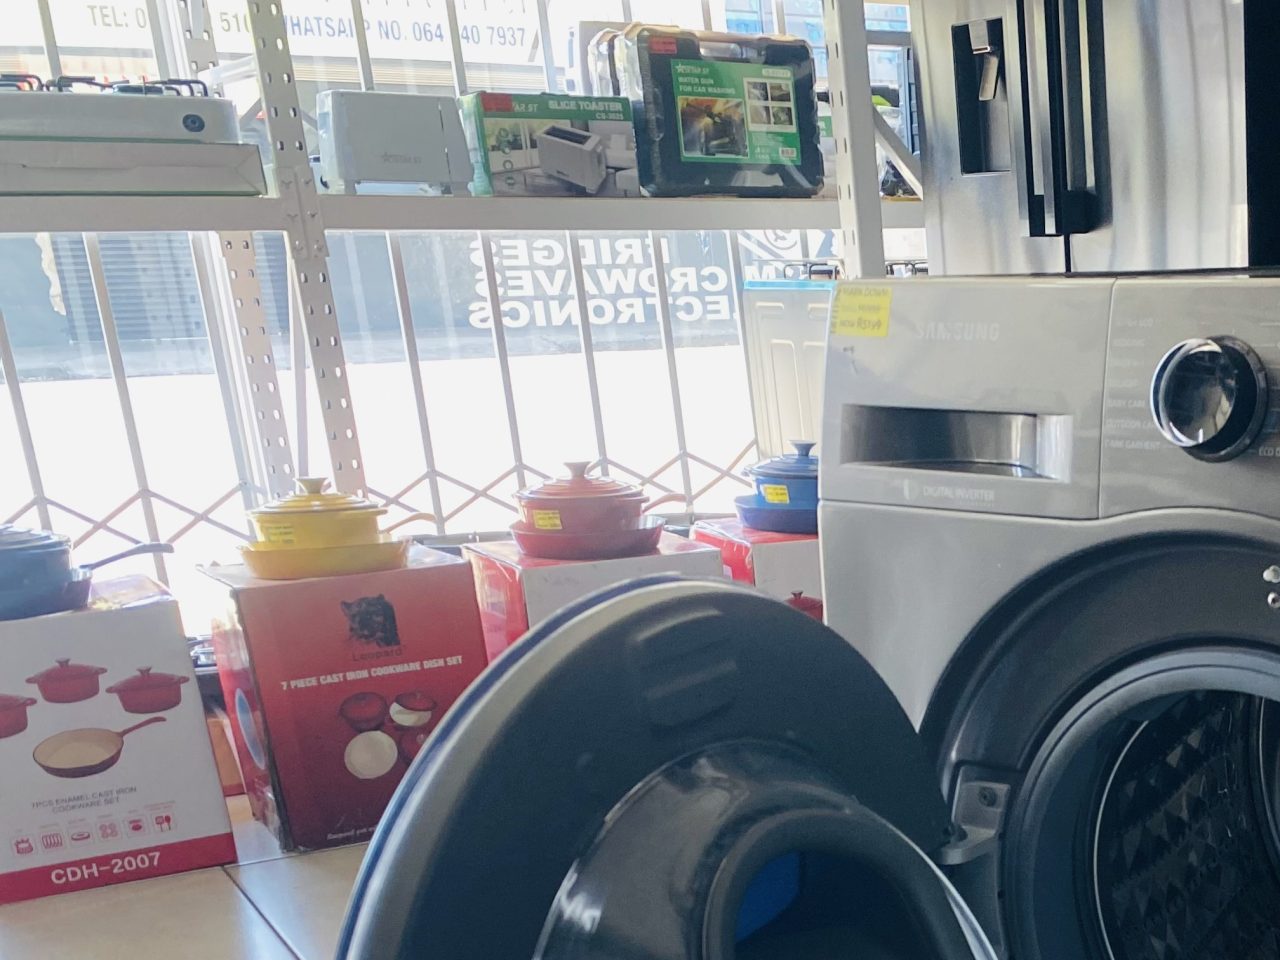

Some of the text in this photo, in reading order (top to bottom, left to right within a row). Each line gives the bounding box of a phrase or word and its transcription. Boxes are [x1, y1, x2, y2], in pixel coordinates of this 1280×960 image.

[87, 4, 129, 28] TEL:
[413, 22, 444, 42] 064
[486, 26, 525, 47] 7937
[916, 320, 1000, 341] SAMSUNG
[280, 655, 463, 691] 7 PIECE CAST IRON COOKWARE DISH SET
[51, 851, 161, 885] CDH-2007
